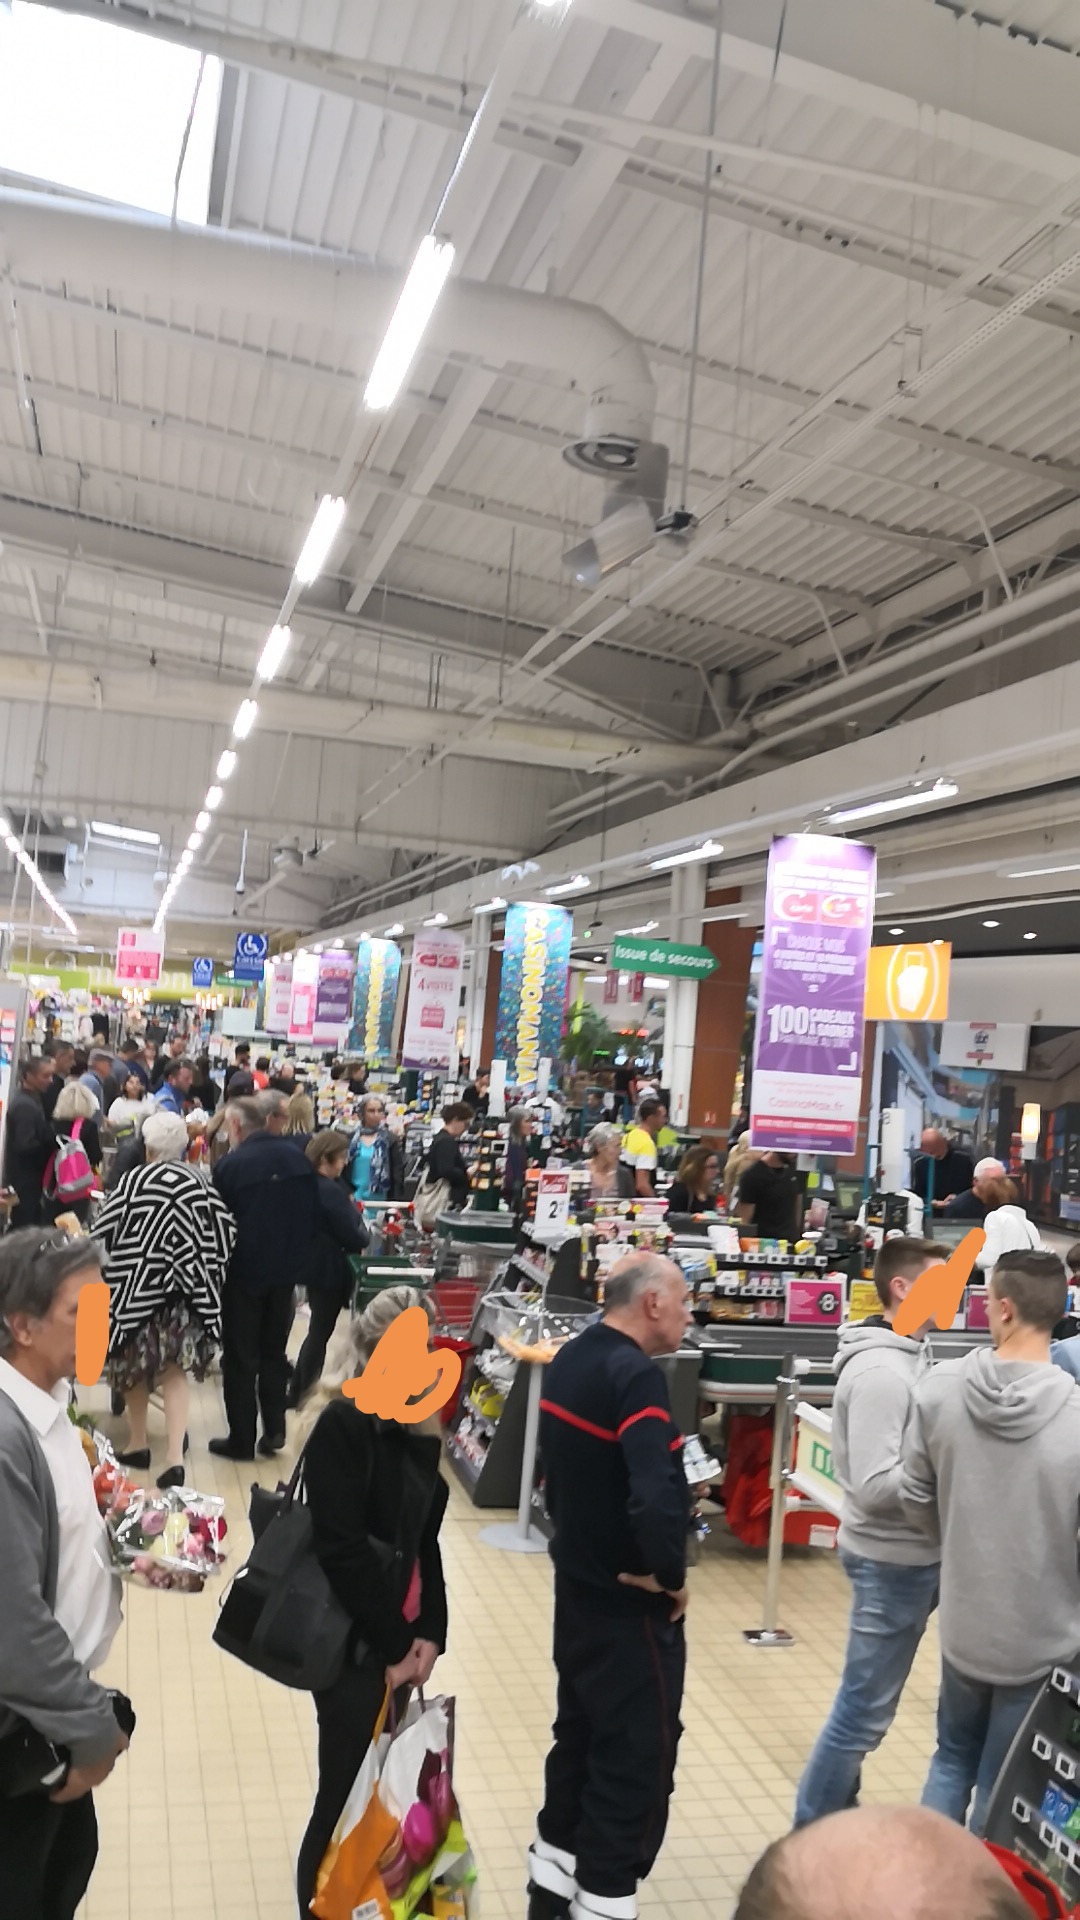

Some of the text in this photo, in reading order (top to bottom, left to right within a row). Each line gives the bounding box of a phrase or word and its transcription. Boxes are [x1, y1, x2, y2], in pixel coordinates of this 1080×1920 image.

[615, 945, 714, 969] Issue de secours
[516, 908, 550, 1085] CASINOMANIA
[767, 1004, 809, 1043] 100
[768, 1097, 844, 1111] CasinoMax.fr
[549, 1200, 558, 1219] 2
